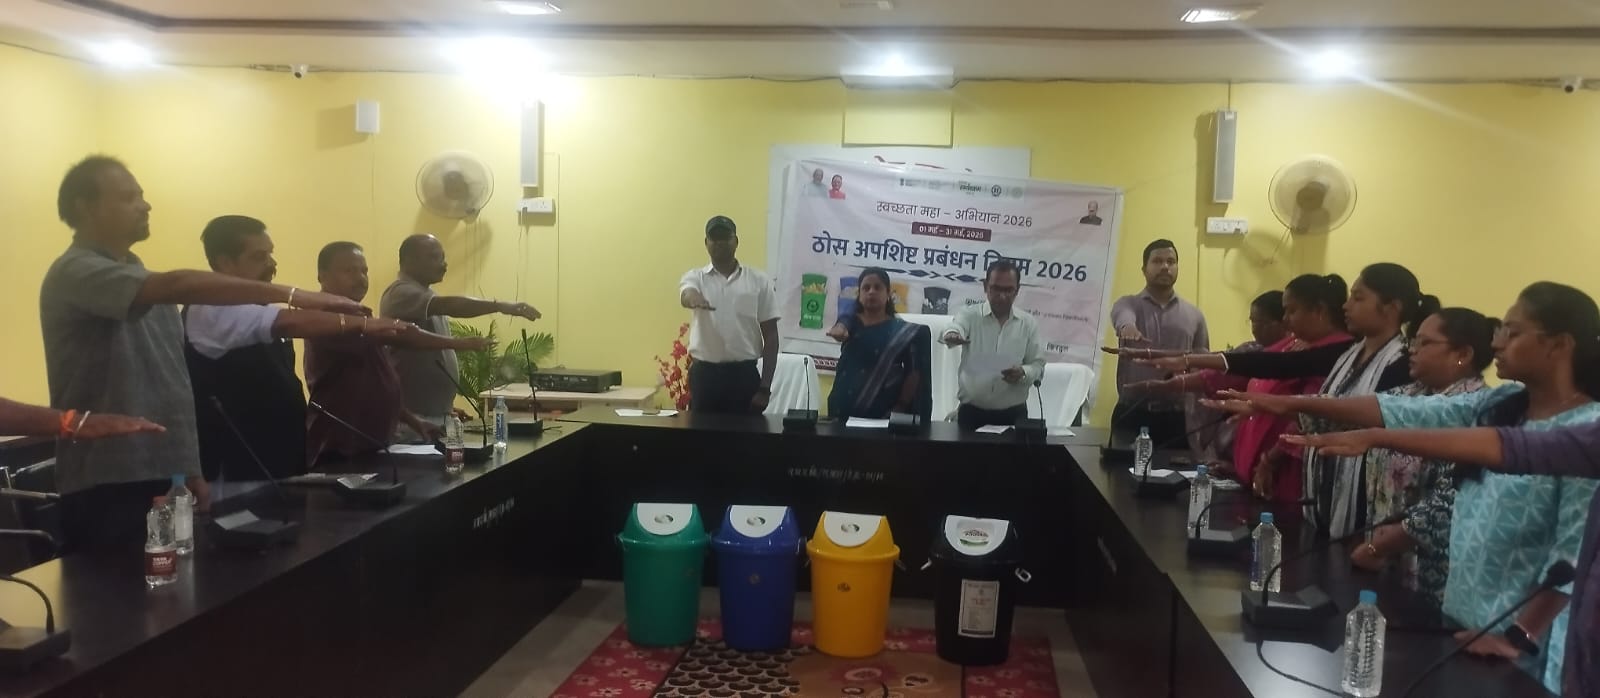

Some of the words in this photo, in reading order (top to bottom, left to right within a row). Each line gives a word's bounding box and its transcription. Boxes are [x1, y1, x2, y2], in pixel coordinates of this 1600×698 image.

[876, 200, 918, 216] स्वच्छता
[920, 206, 941, 219] महा
[954, 207, 1001, 224] अभियान
[1003, 214, 1032, 228] 2026
[812, 231, 849, 256] ठोस
[853, 238, 919, 265] अपशिष्ट
[923, 244, 979, 270] प्रबंधन
[1036, 260, 1087, 282] 2026
